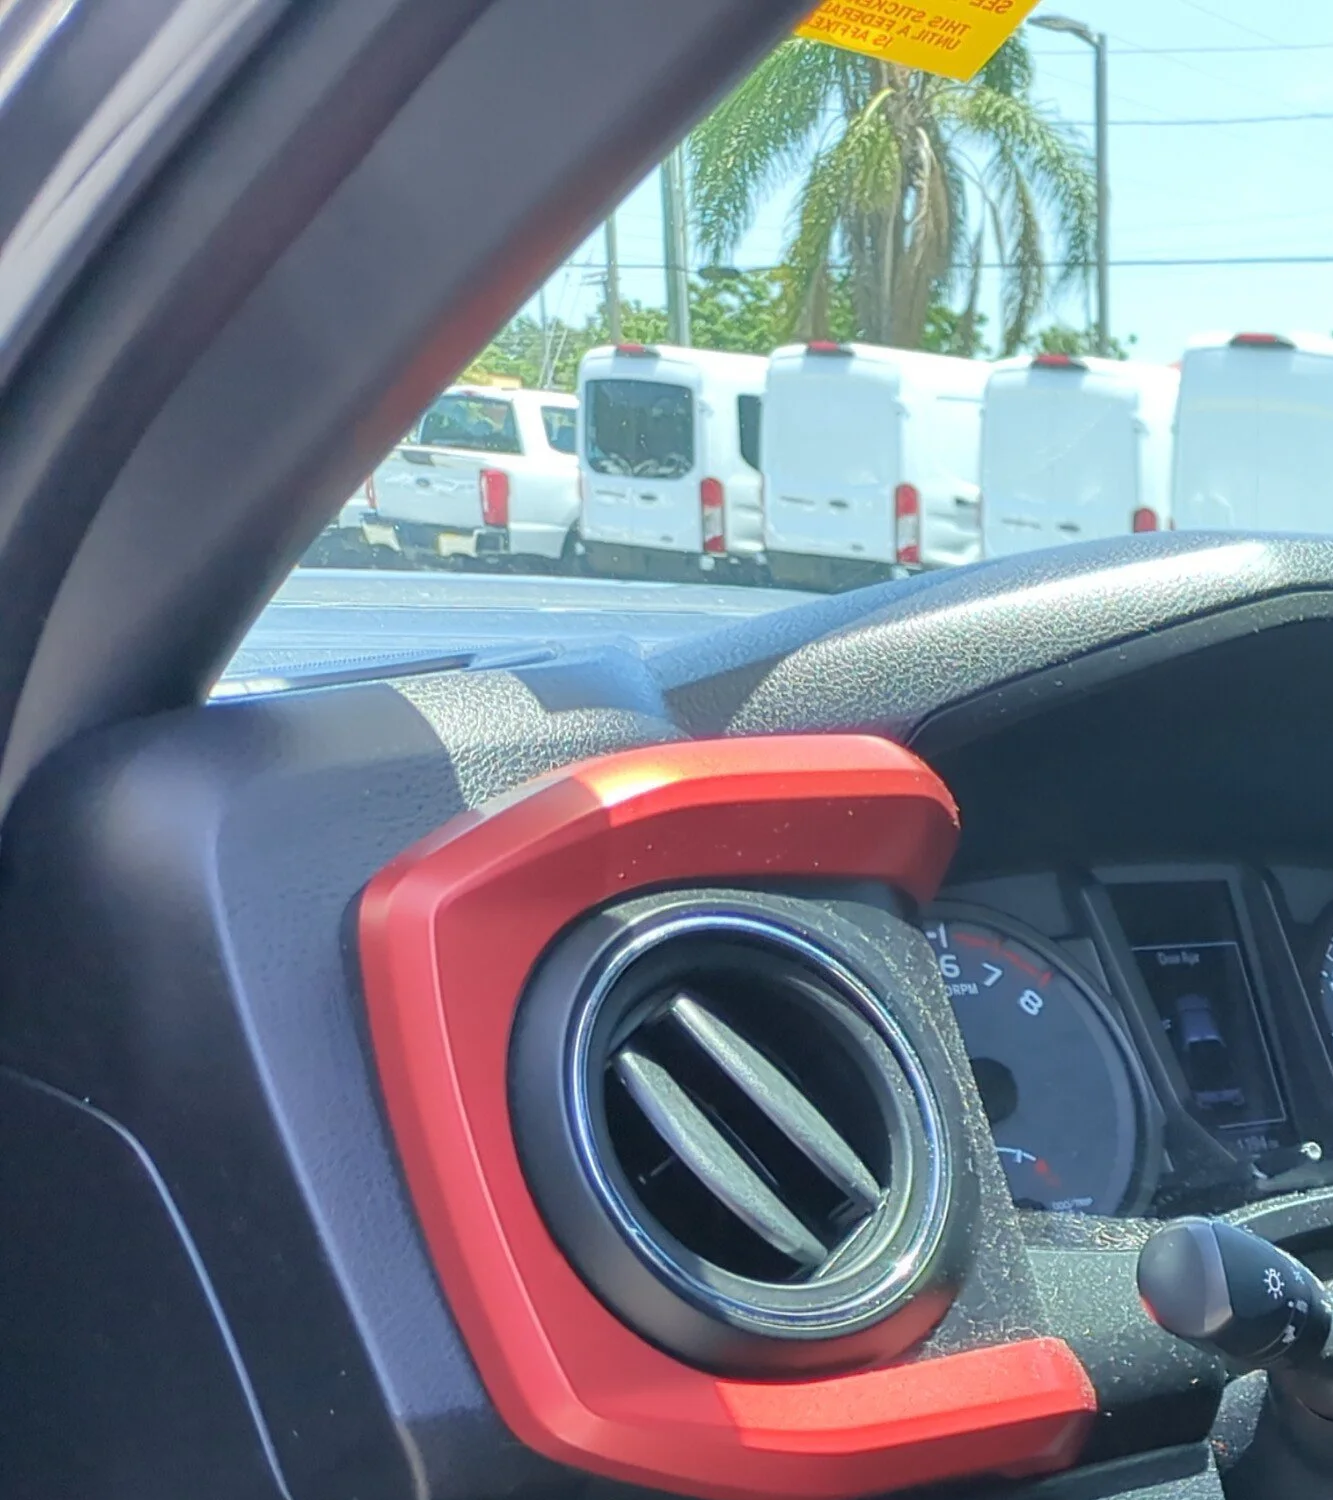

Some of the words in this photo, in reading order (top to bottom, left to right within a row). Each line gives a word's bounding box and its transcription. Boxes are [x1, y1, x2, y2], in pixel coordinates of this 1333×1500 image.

[939, 954, 961, 979] 6
[981, 962, 1003, 987] 7
[1019, 988, 1044, 1017] 8
